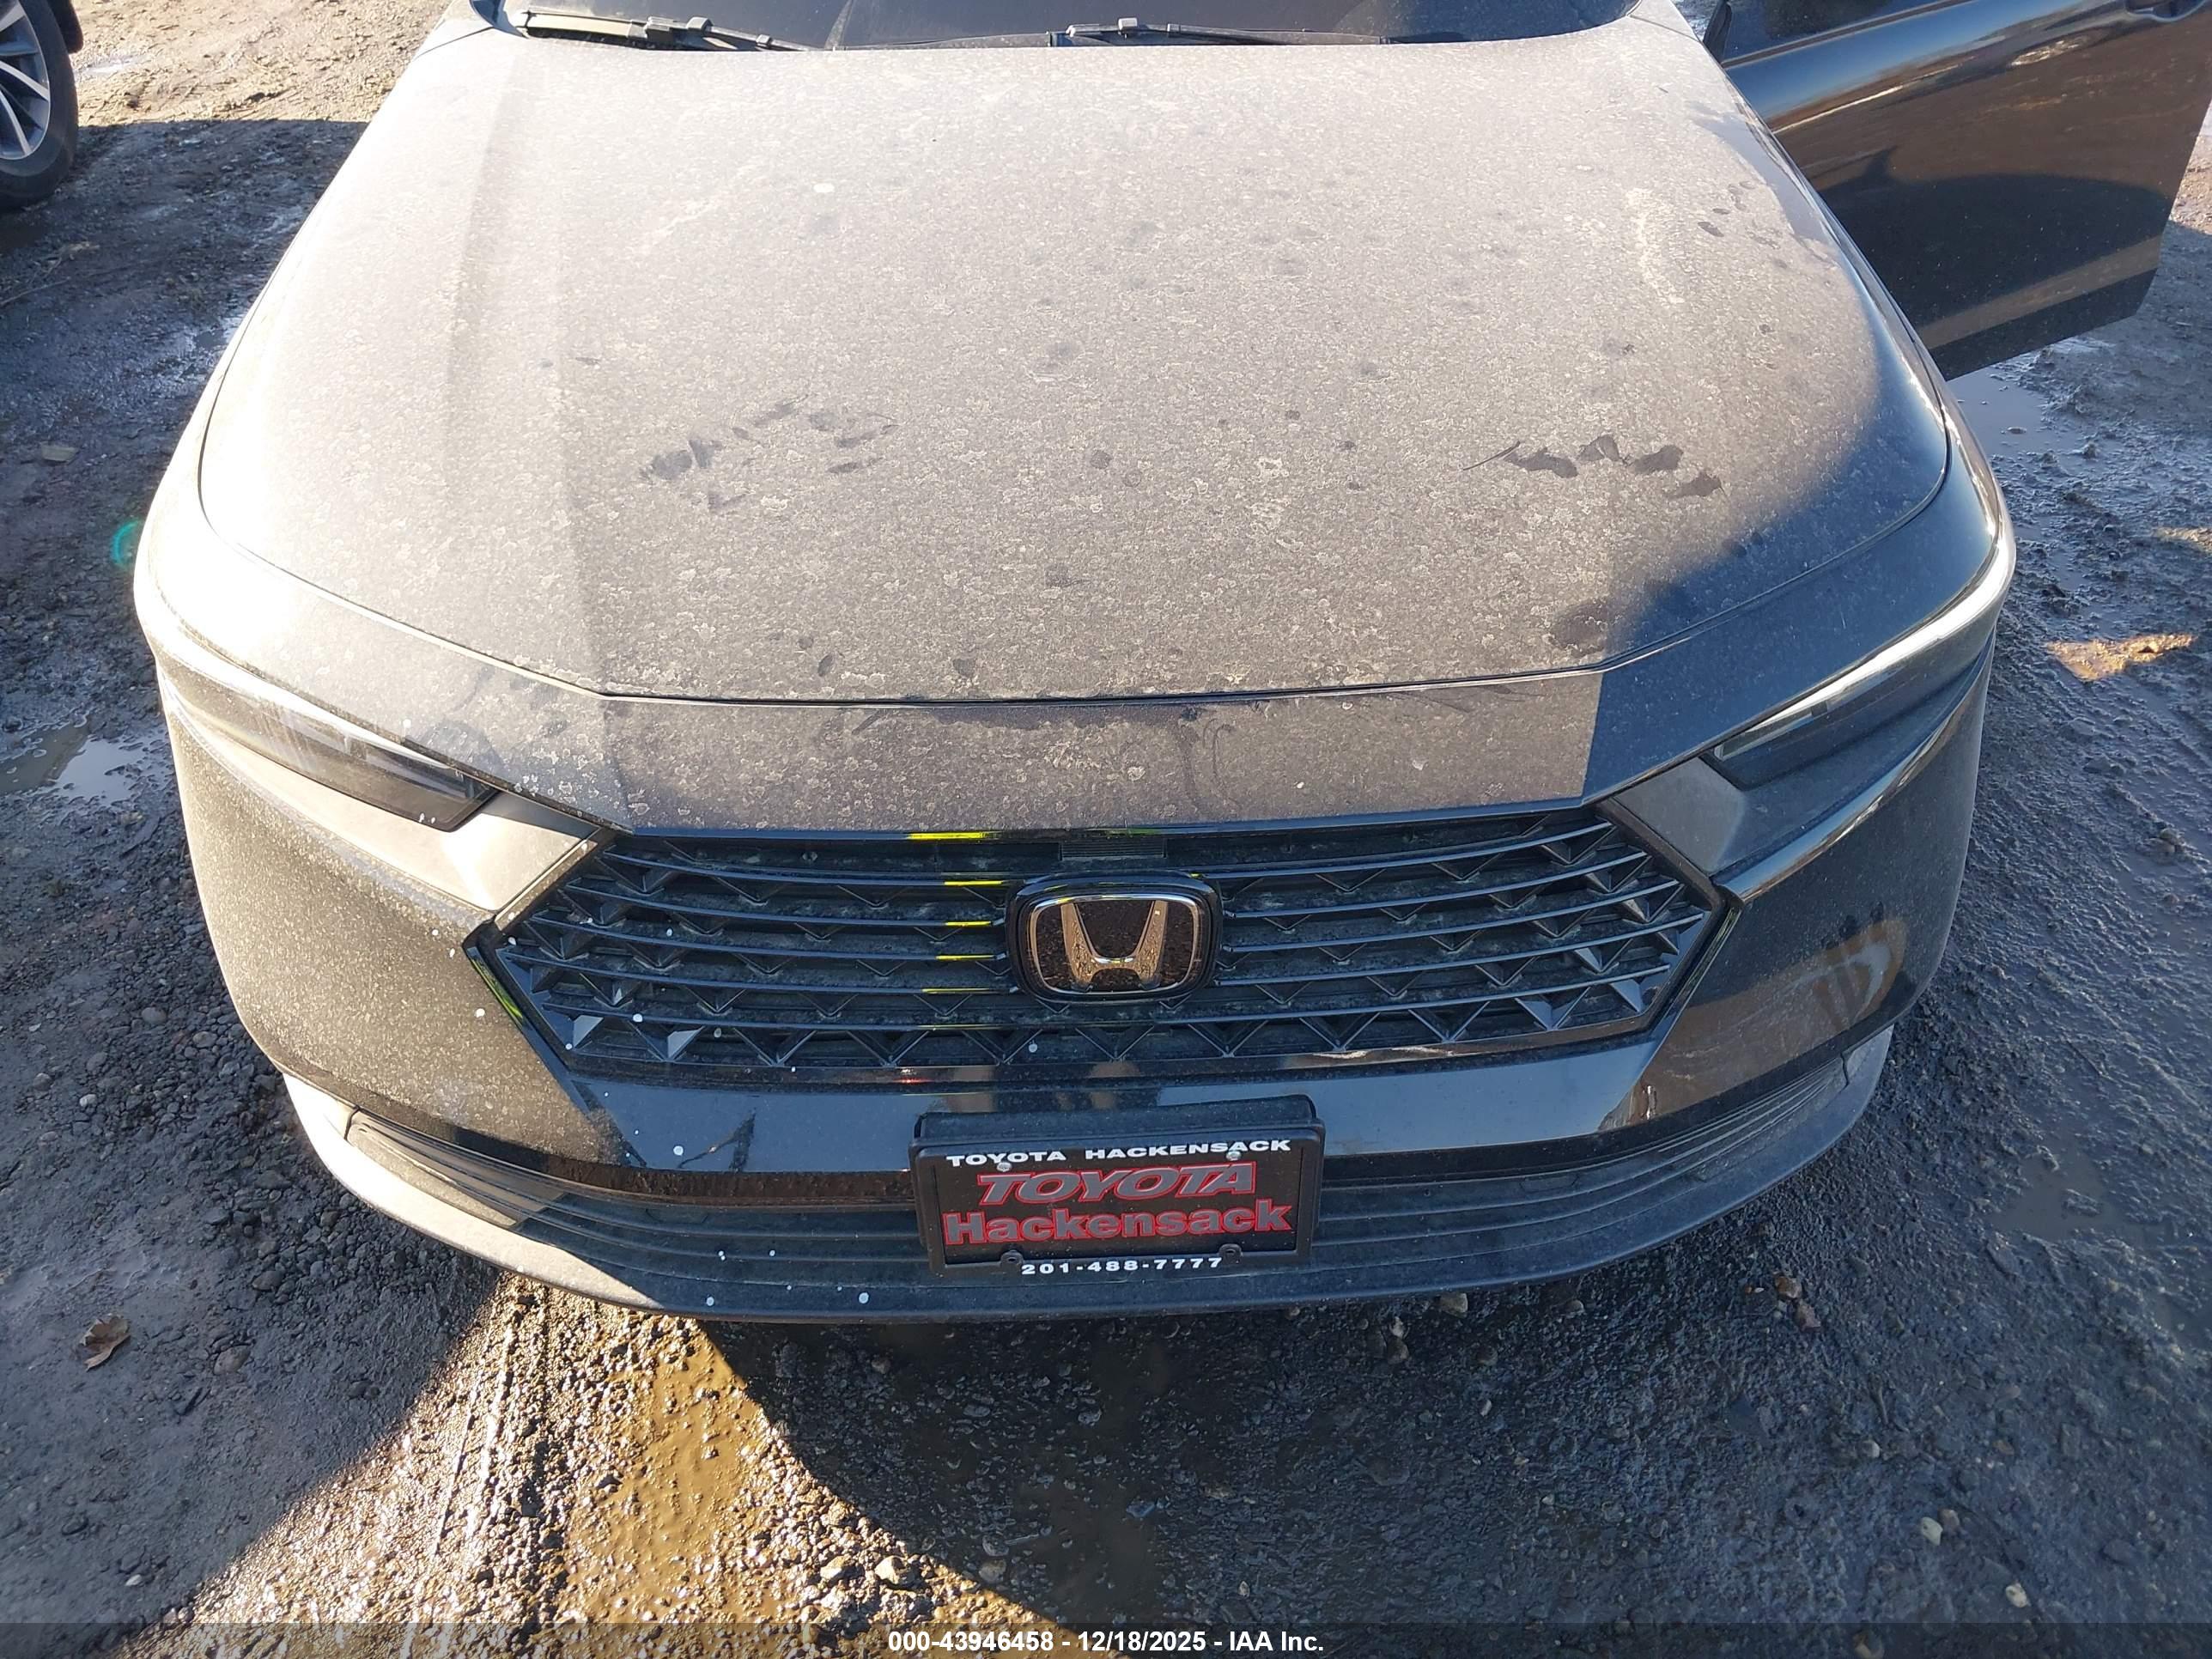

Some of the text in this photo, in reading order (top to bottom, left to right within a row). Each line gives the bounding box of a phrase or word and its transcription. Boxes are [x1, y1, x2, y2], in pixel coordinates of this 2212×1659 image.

[946, 1139, 1291, 1168] TOYOTA HACKENSACK
[977, 1161, 1257, 1206] TOYOTA
[942, 1198, 1292, 1245] Hackensack
[1021, 1257, 1223, 1276] 201-488-7777
